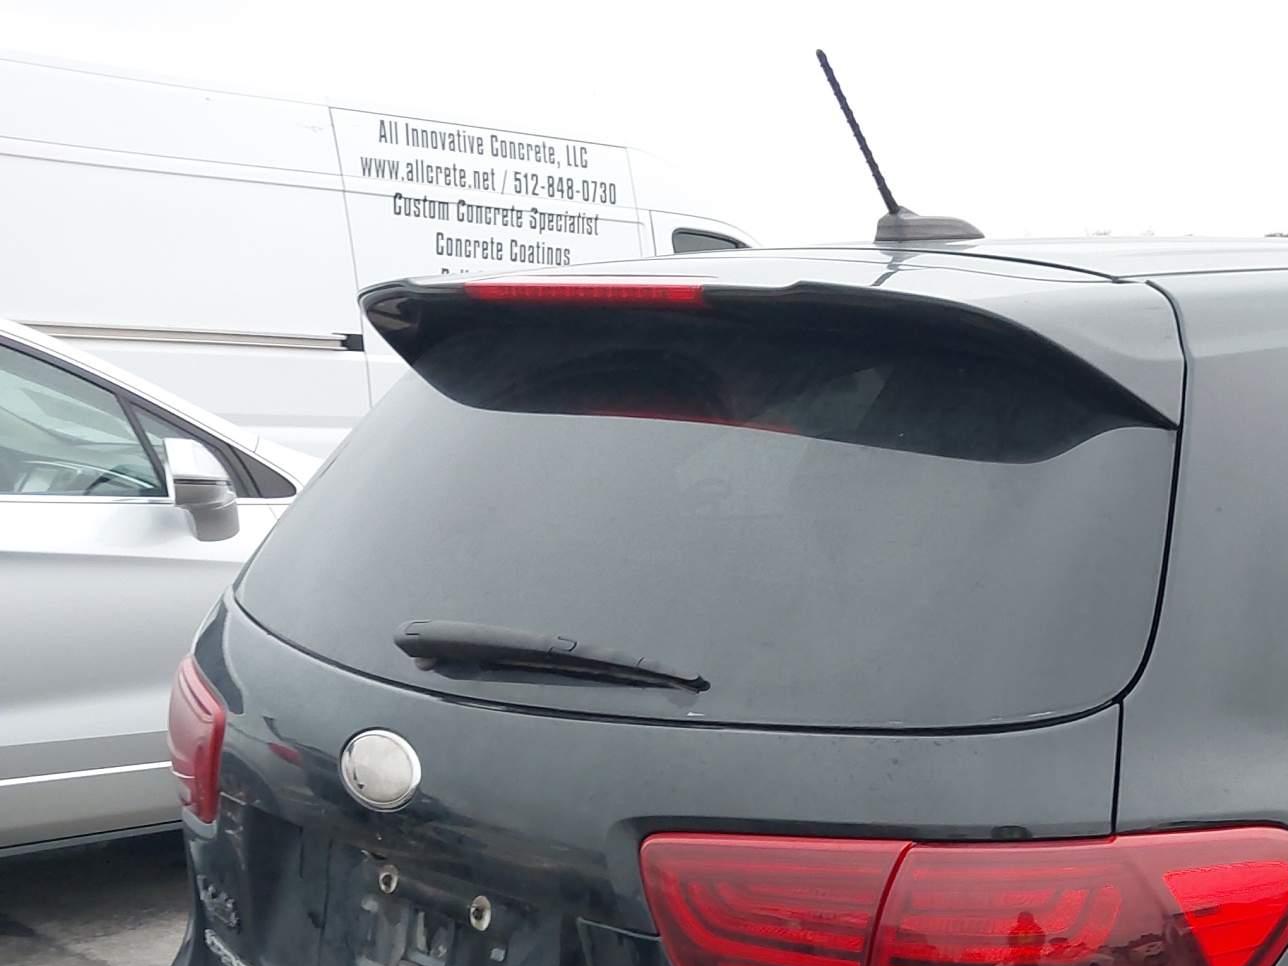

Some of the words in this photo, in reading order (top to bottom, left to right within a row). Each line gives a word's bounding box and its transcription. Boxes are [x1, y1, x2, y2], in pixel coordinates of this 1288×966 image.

[378, 119, 399, 145] All
[405, 122, 484, 156] Innovative
[490, 134, 561, 169] Concrete,
[566, 144, 588, 169] LLC
[360, 156, 496, 192] www.allcrete.net
[500, 169, 508, 195] /
[513, 171, 617, 205] 512-848-0730
[393, 192, 449, 221] Custom
[457, 199, 523, 228] Concrete
[529, 206, 599, 236] Specialist
[436, 232, 503, 261] Concrete
